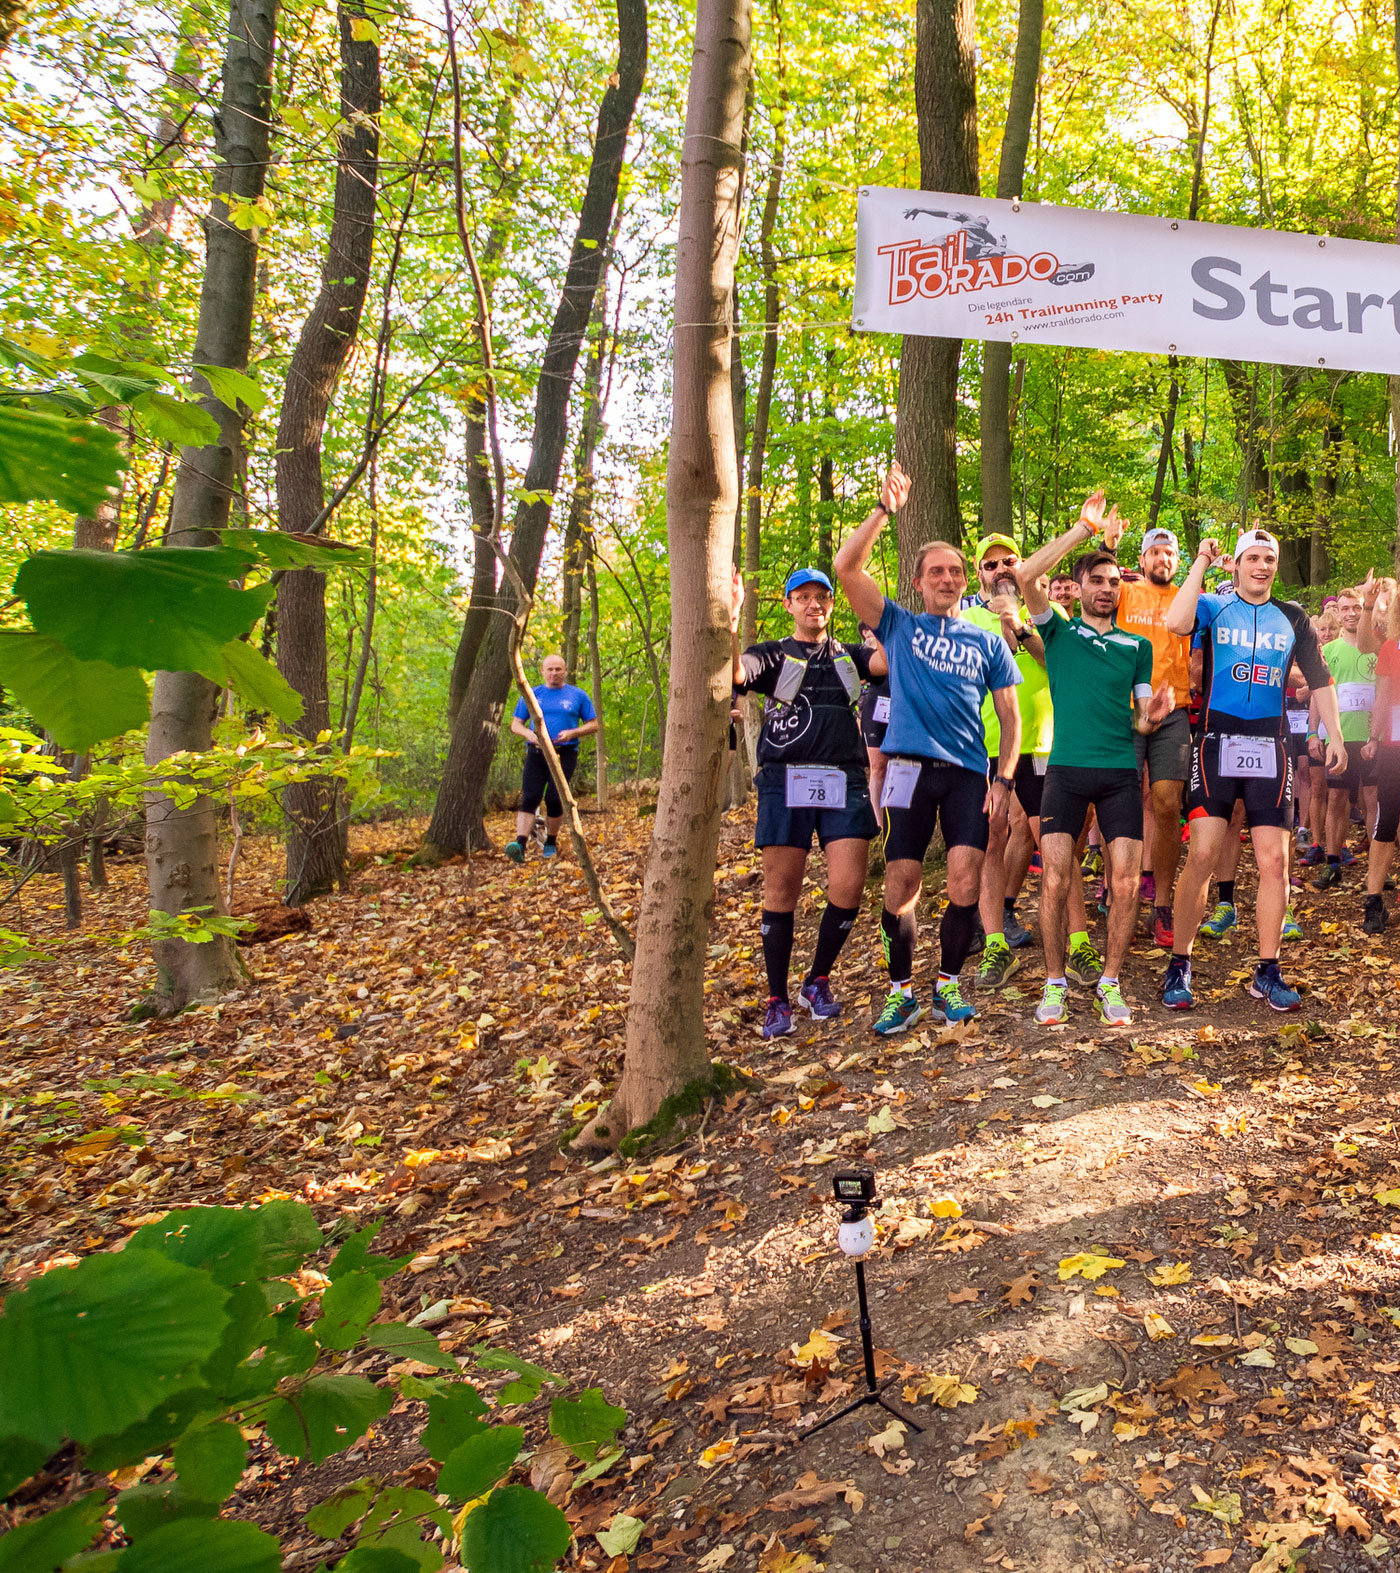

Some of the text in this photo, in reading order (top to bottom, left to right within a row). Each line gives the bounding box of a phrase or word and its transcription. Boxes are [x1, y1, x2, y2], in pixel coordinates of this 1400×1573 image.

[878, 229, 967, 277] Trail
[968, 296, 1033, 313] Die legendäre
[984, 292, 1164, 326] 24h Trailrunning Party
[1023, 310, 1125, 332] www.traildorado.com
[1217, 627, 1287, 651] BILKE
[1231, 663, 1283, 688] GER
[1349, 698, 1366, 706] 114
[1236, 756, 1263, 769] 201
[1284, 756, 1292, 801] APTONIA
[808, 788, 826, 801] 78
